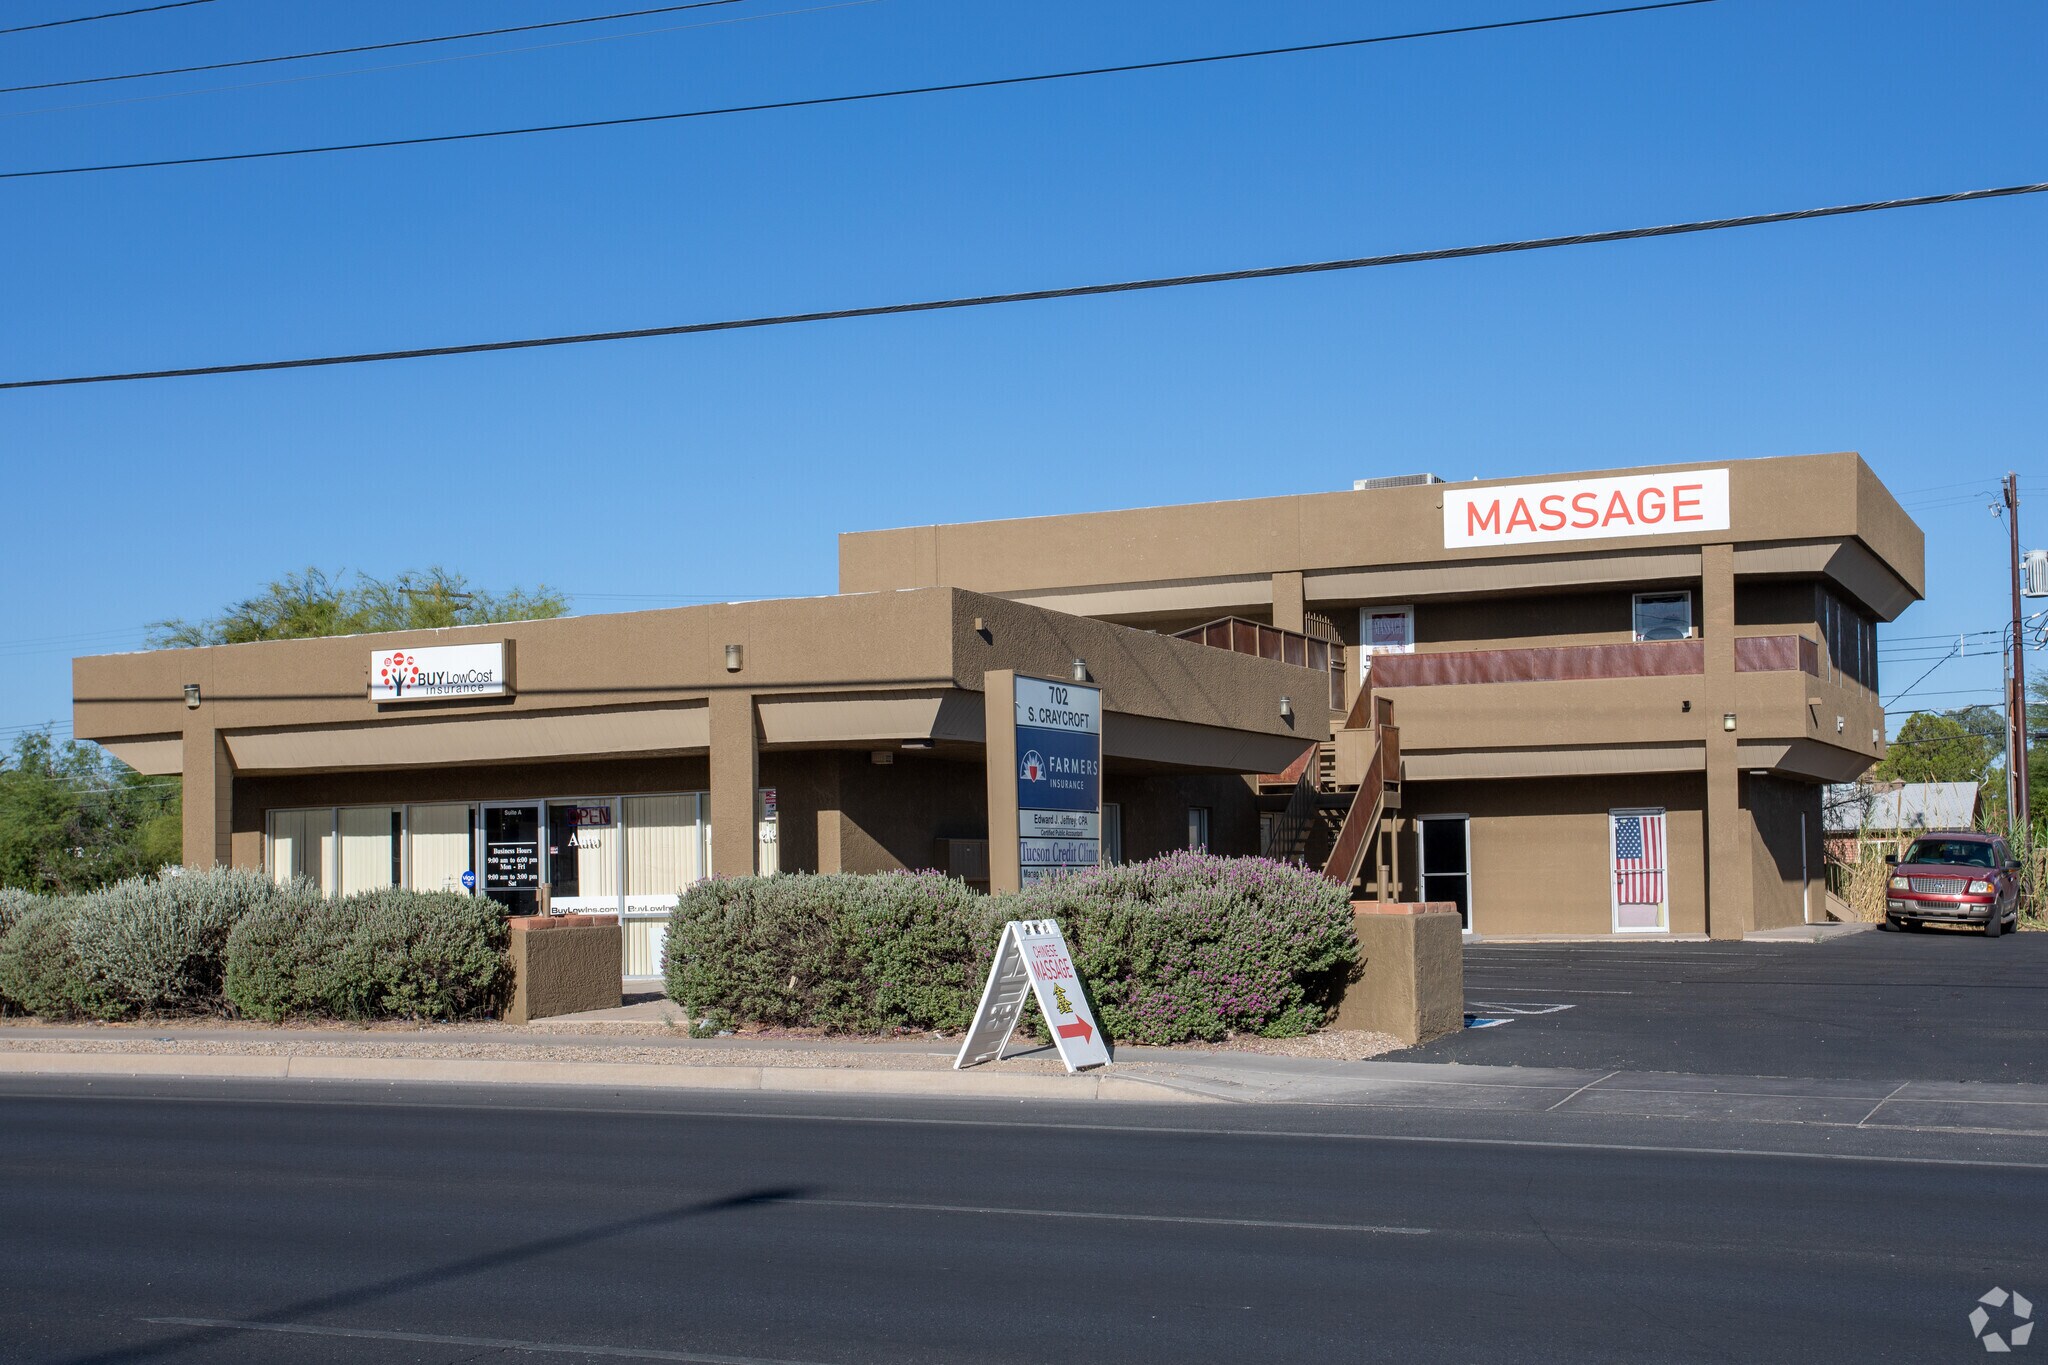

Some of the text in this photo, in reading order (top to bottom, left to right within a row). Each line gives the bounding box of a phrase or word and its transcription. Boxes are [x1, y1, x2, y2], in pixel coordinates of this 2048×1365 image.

[1466, 483, 1704, 537] MASSAGE
[418, 669, 493, 686] BUY LowCost
[426, 683, 484, 695] insurance
[1048, 686, 1069, 706] 702
[1028, 706, 1090, 729] S. CRAYCROFT
[1049, 756, 1098, 776] FARMERS
[1050, 779, 1084, 790] INSURANCE
[567, 807, 610, 825] OPEN
[1034, 814, 1053, 825] Edward
[1078, 816, 1088, 826] CPA
[567, 832, 602, 849] Auto
[1021, 841, 1099, 863] Tucson Credit Clinic
[528, 857, 538, 865] pm
[462, 875, 475, 883] vigo
[1032, 944, 1059, 959] CHINESE
[1031, 957, 1073, 981] MASSAGE
